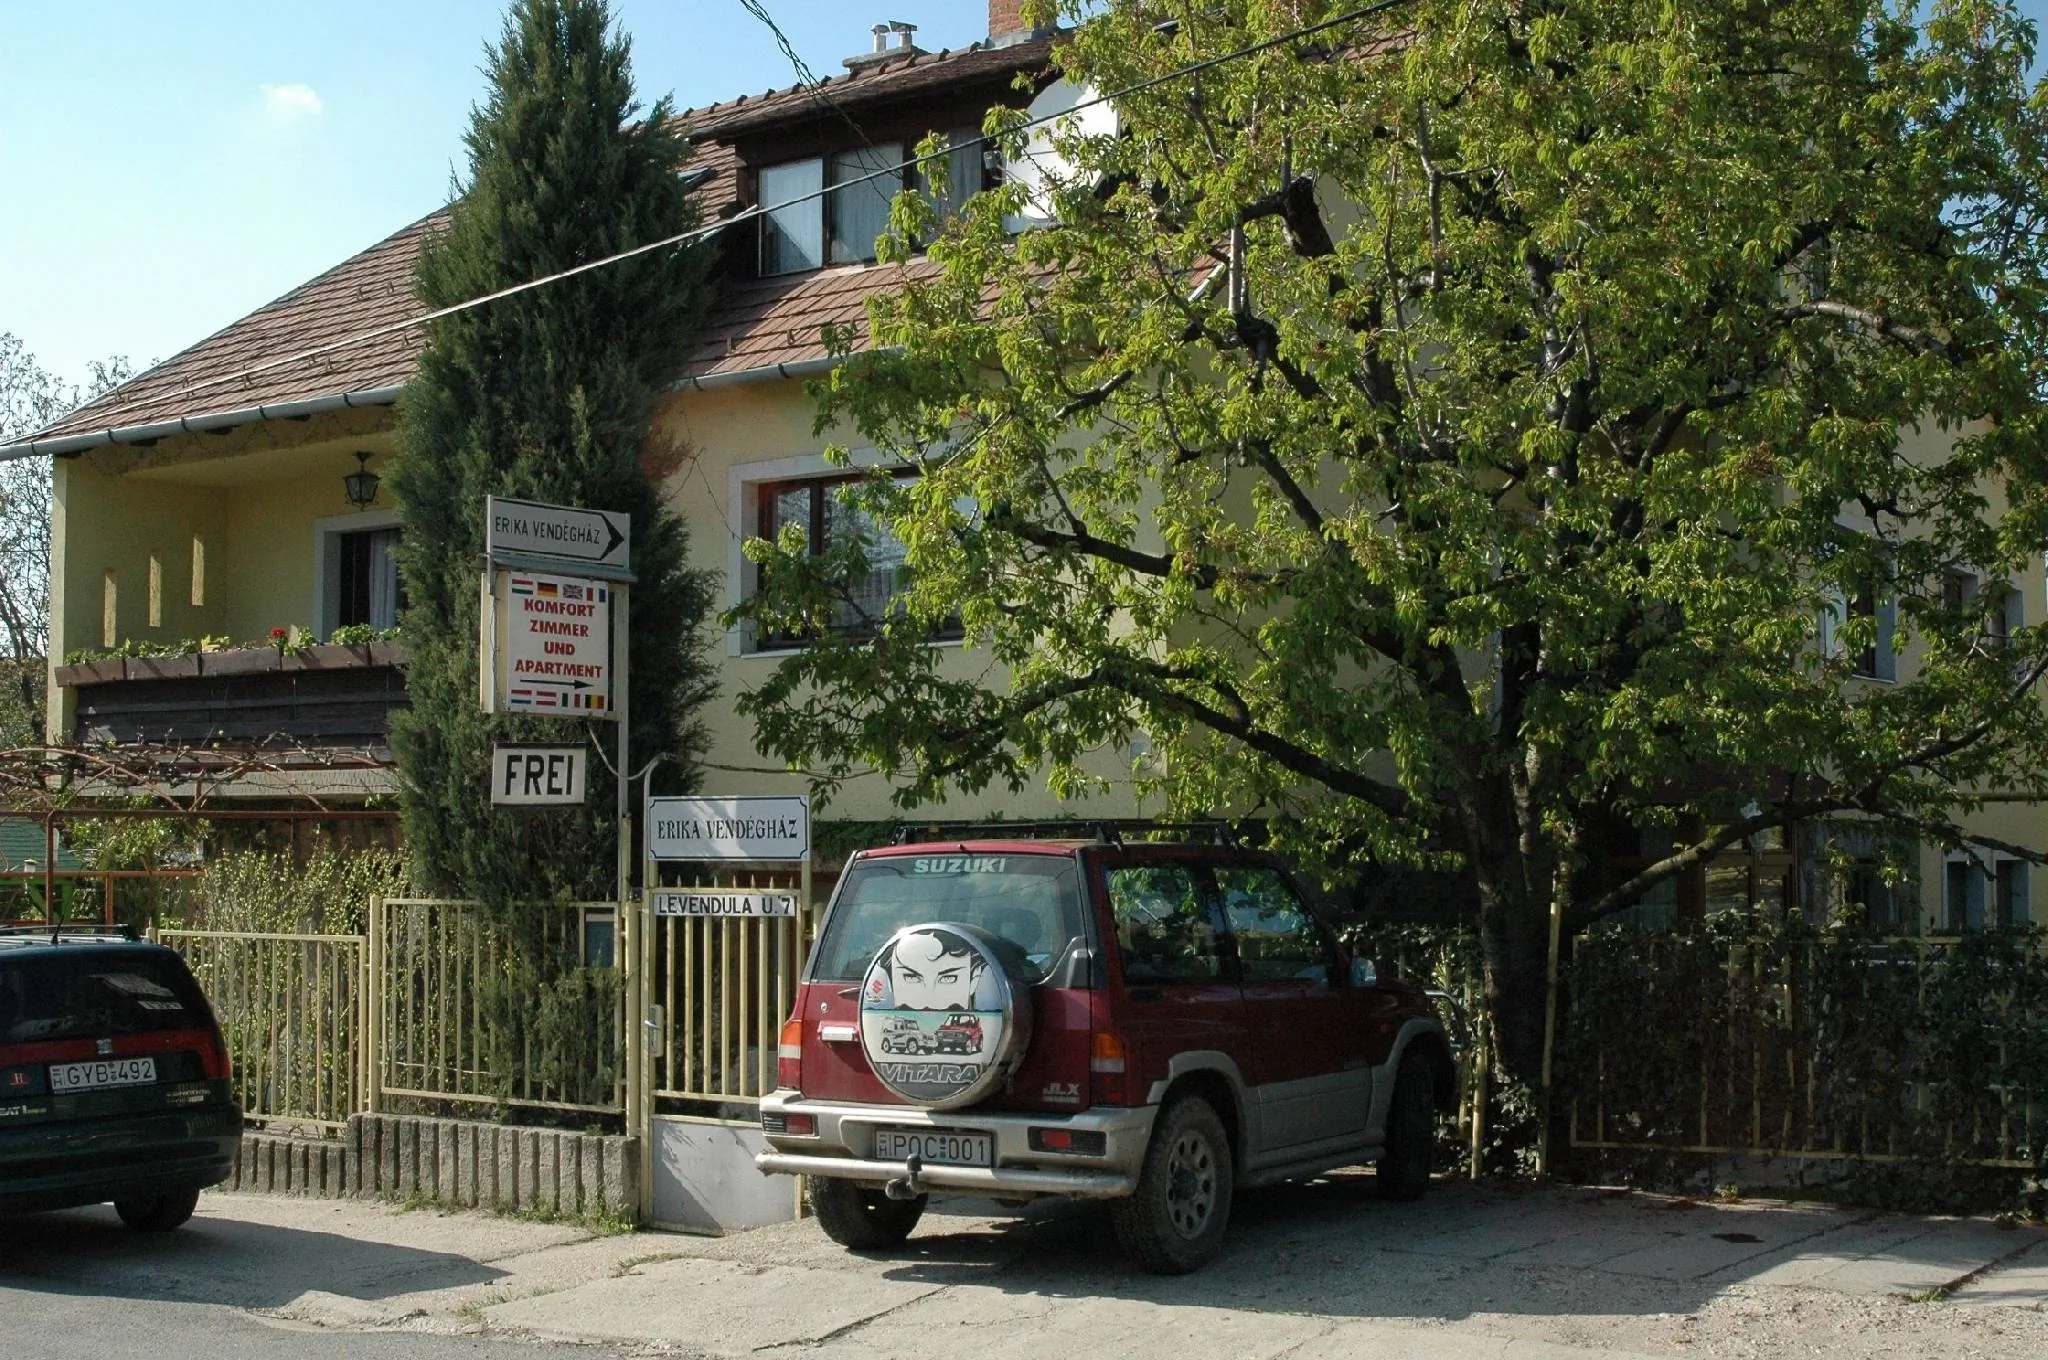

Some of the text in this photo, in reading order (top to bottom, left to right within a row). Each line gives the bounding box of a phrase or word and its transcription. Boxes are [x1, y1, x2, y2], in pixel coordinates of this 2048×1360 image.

[495, 516, 600, 545] ERIKA VENDÉGHÁZ
[524, 598, 595, 617] KOMFORT
[530, 619, 589, 637] ZIMMER
[544, 641, 575, 655] UND
[515, 659, 603, 678] APARTMENT
[505, 754, 574, 796] FREI
[657, 815, 798, 840] ERIKA VENDÉGHÁZ
[913, 858, 1007, 873] SUZUKI
[659, 895, 791, 914] LEVENDULA U. 7
[880, 1063, 982, 1083] VITARA
